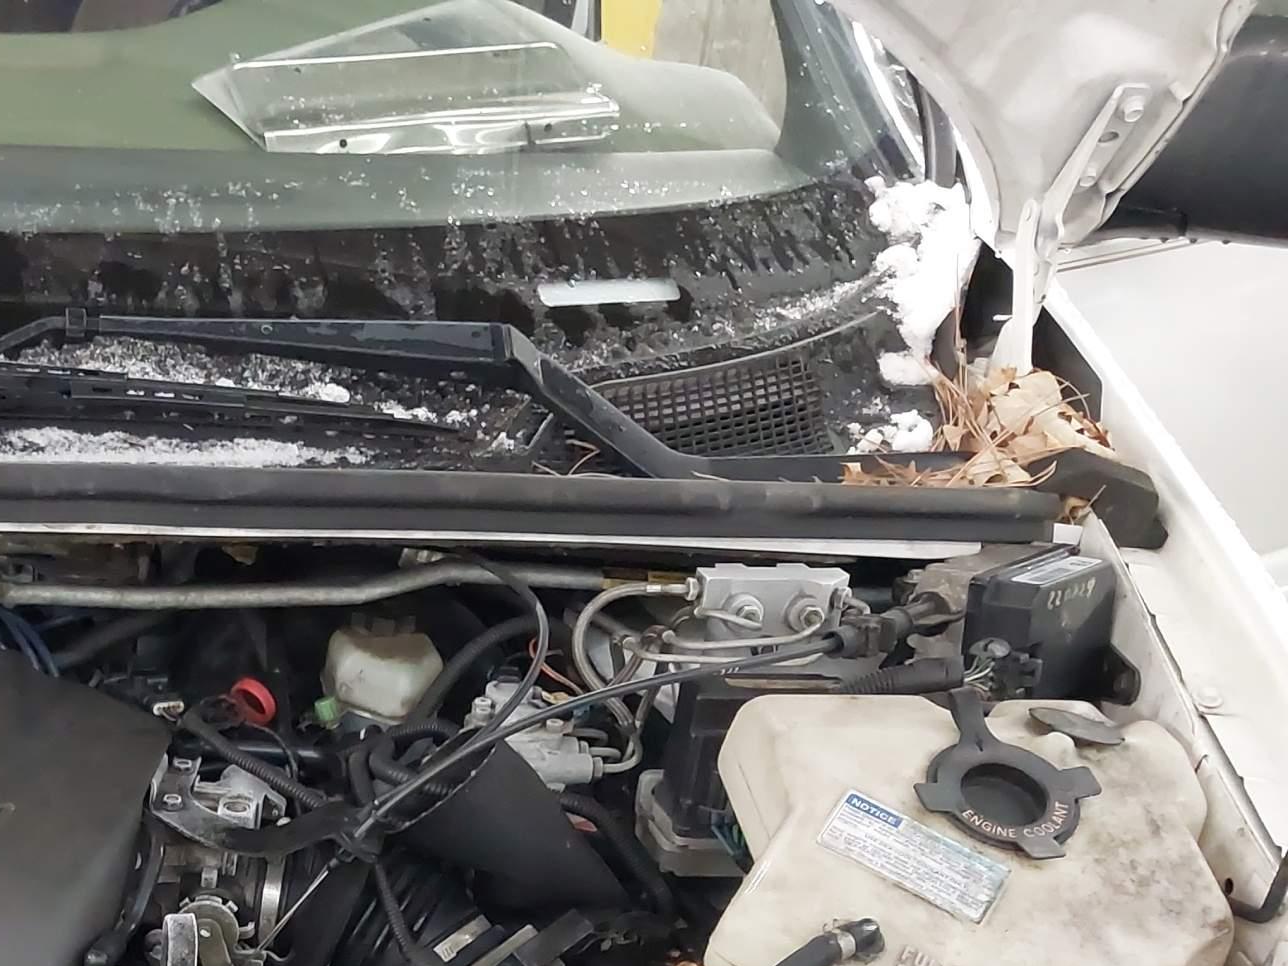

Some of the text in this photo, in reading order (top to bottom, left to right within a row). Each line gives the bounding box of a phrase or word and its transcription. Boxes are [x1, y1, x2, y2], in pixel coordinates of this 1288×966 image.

[851, 797, 898, 826] NOTICE
[962, 800, 1070, 838] ENGINE COOLANT
